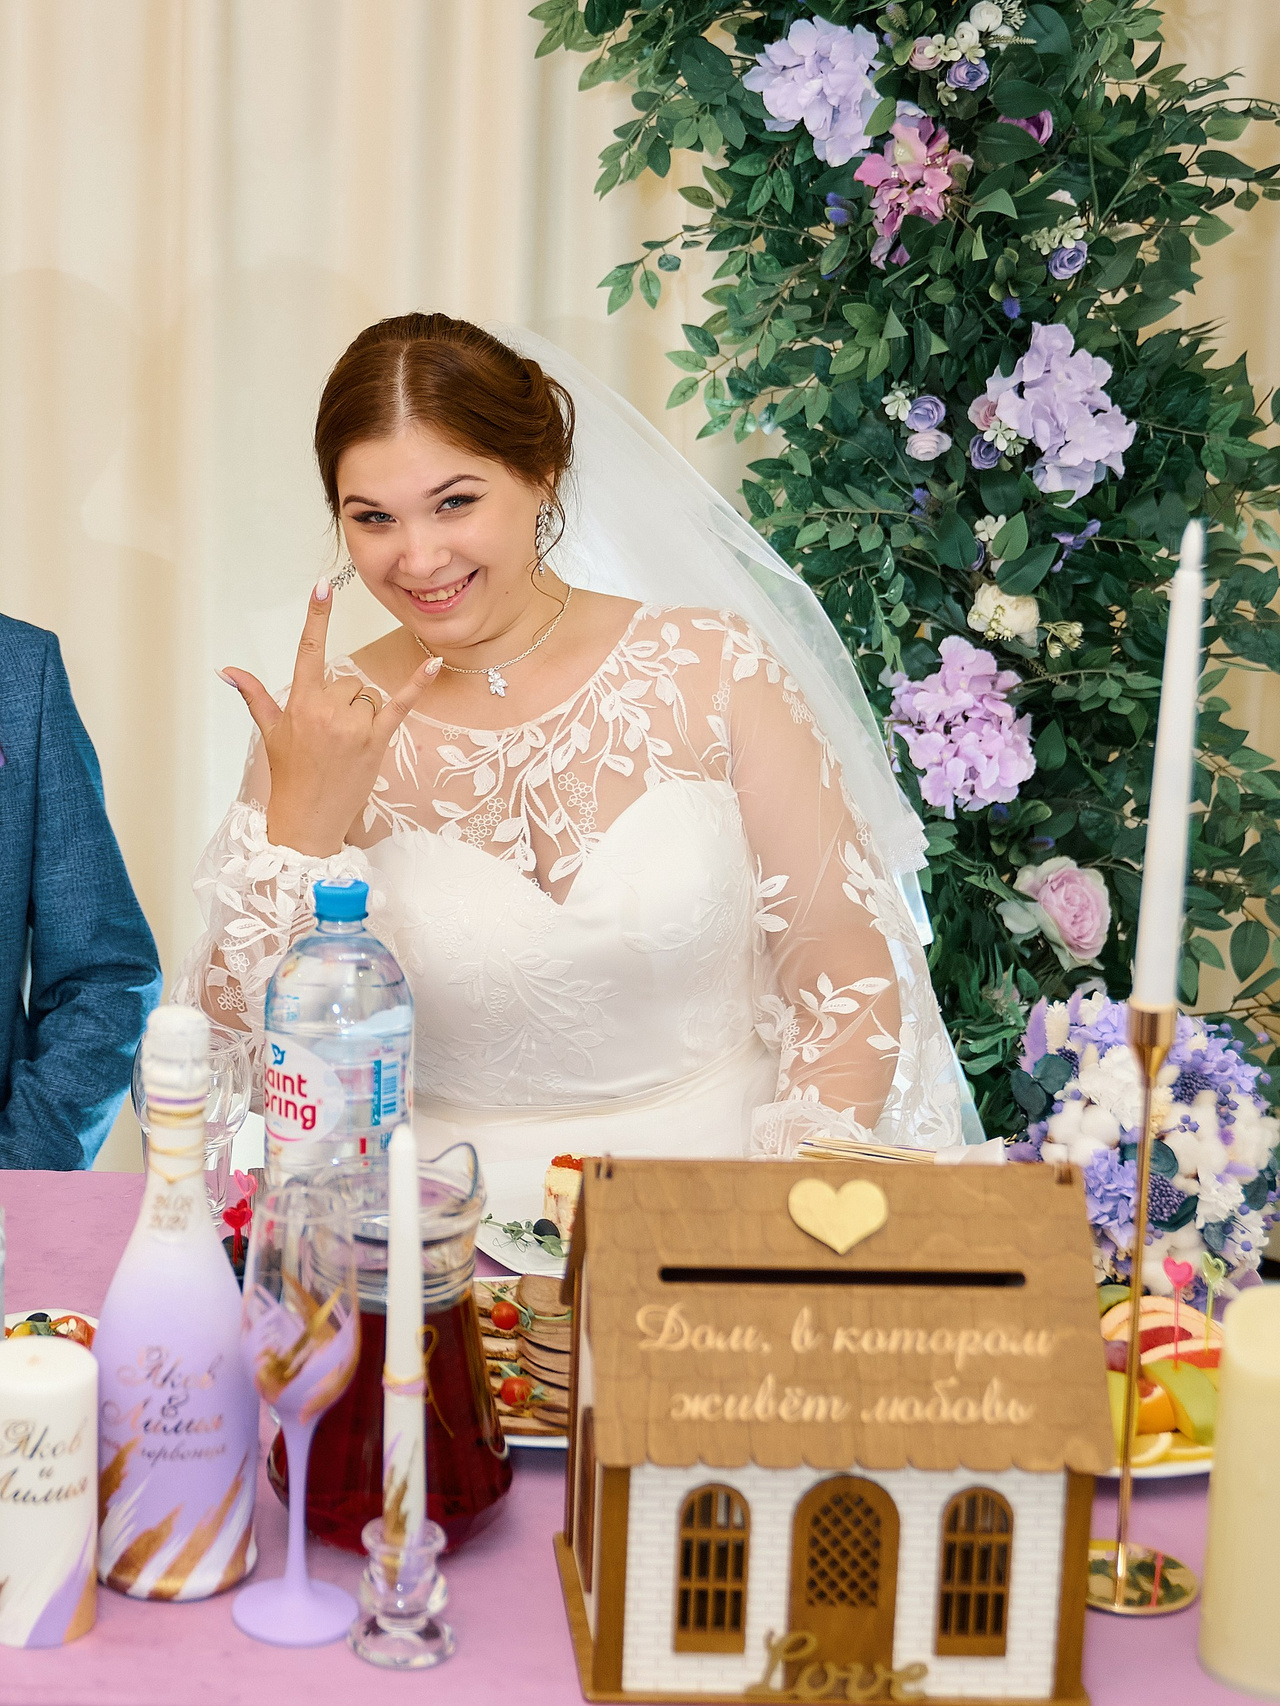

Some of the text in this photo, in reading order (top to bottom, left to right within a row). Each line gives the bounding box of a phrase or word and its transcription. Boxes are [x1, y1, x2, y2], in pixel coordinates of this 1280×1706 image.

[636, 1302, 1054, 1371] Дом, в котором
[116, 1345, 225, 1390] Яков
[669, 1372, 1036, 1425] живёт любовь
[38, 1465, 55, 1479] и
[744, 1629, 929, 1701] Love
